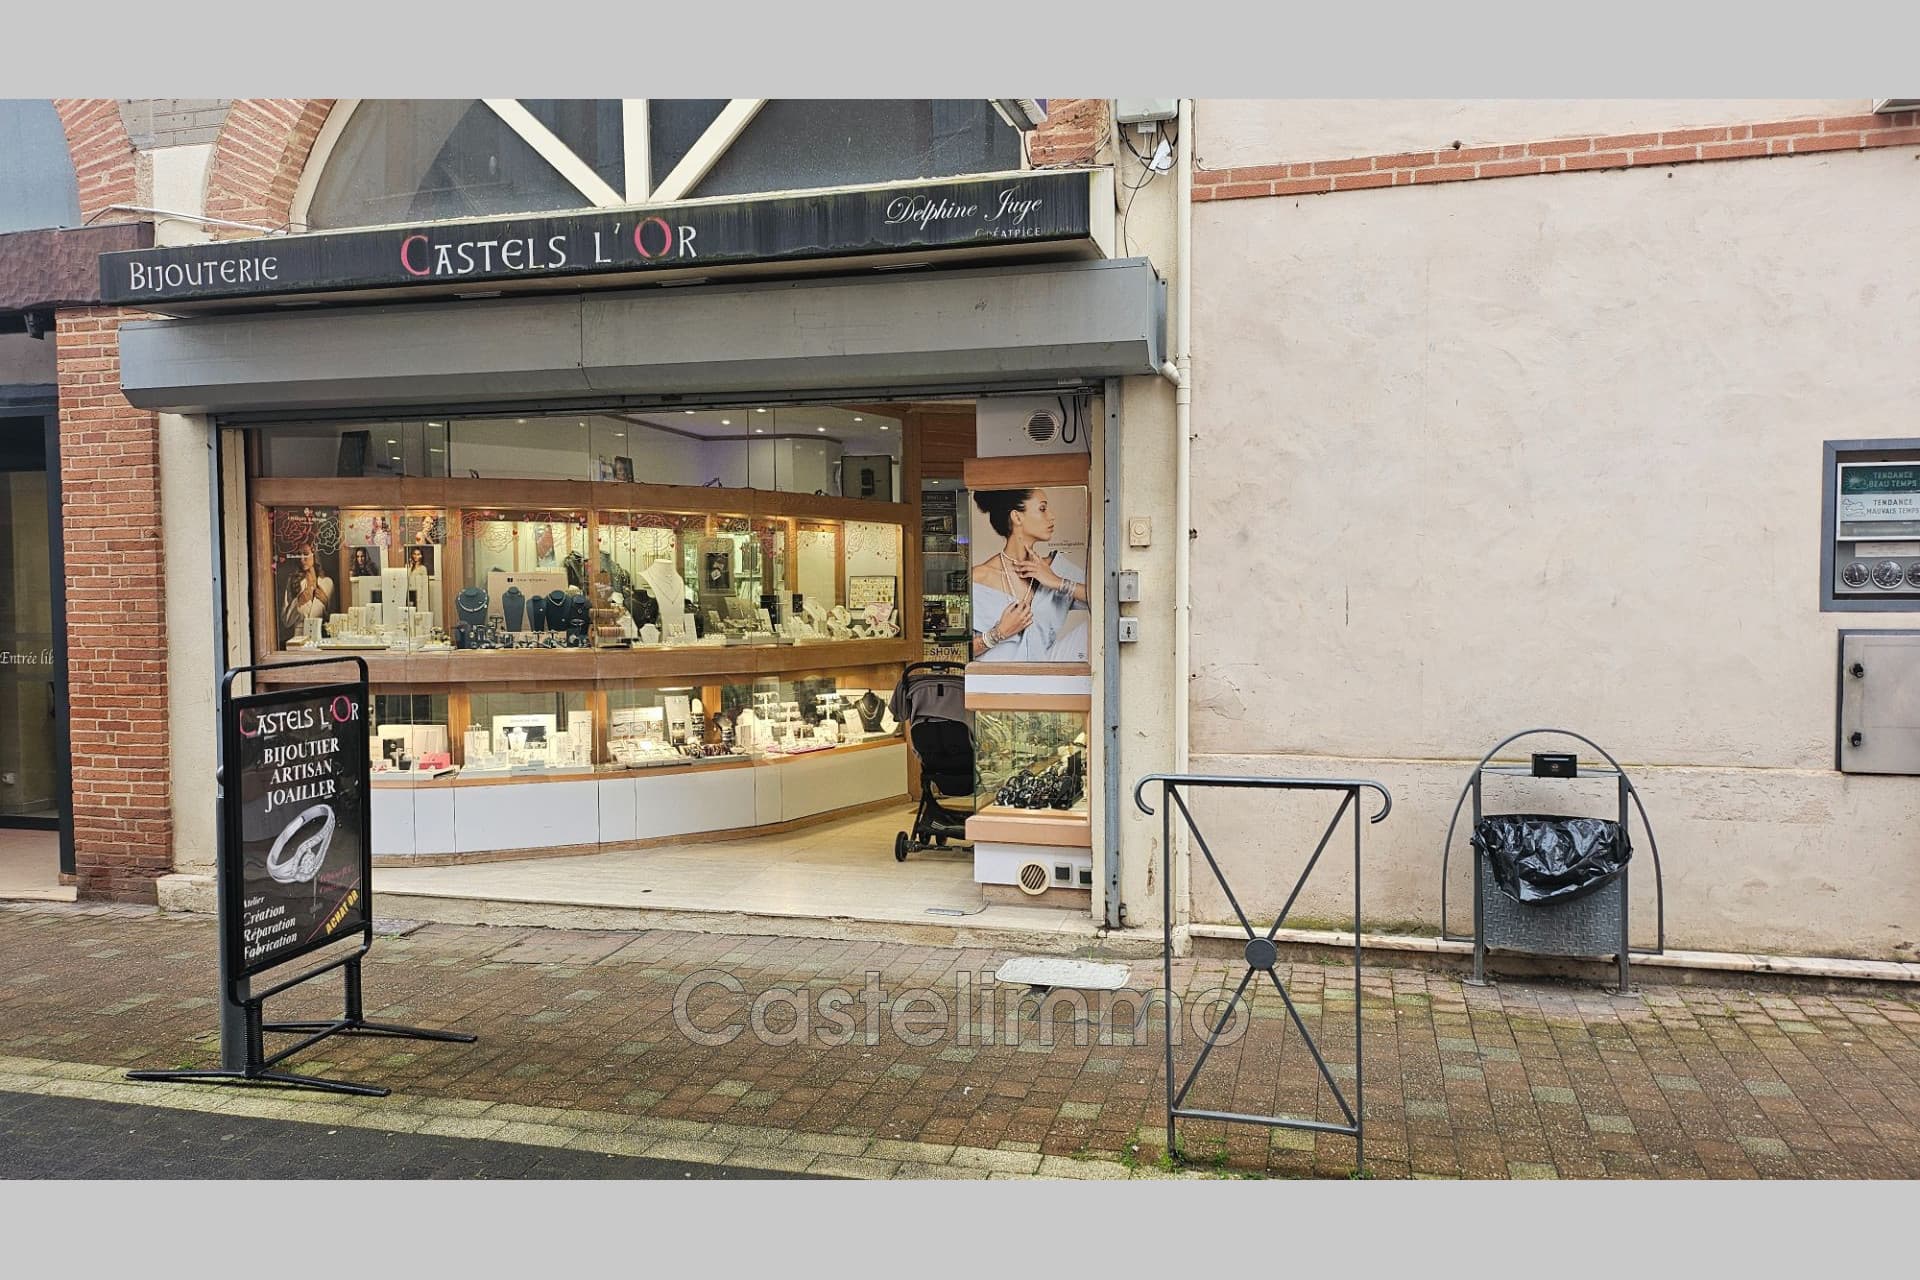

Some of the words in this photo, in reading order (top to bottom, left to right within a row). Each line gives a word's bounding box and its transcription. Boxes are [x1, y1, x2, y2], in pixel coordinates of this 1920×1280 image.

[884, 195, 978, 231] Delphine
[983, 184, 1043, 225] Juge
[400, 234, 568, 277] CASTELS
[1891, 479, 1917, 487] TEMPS
[1873, 498, 1913, 506] TENDANCE
[0, 650, 37, 665] Entrée
[263, 737, 341, 768] BIJOUTIER
[270, 758, 333, 785] ARTISAN
[243, 904, 286, 927] Création
[325, 901, 349, 935] ACHAT
[347, 889, 359, 906] OR
[243, 917, 297, 944] Réparation
[244, 932, 298, 961] Fabrication
